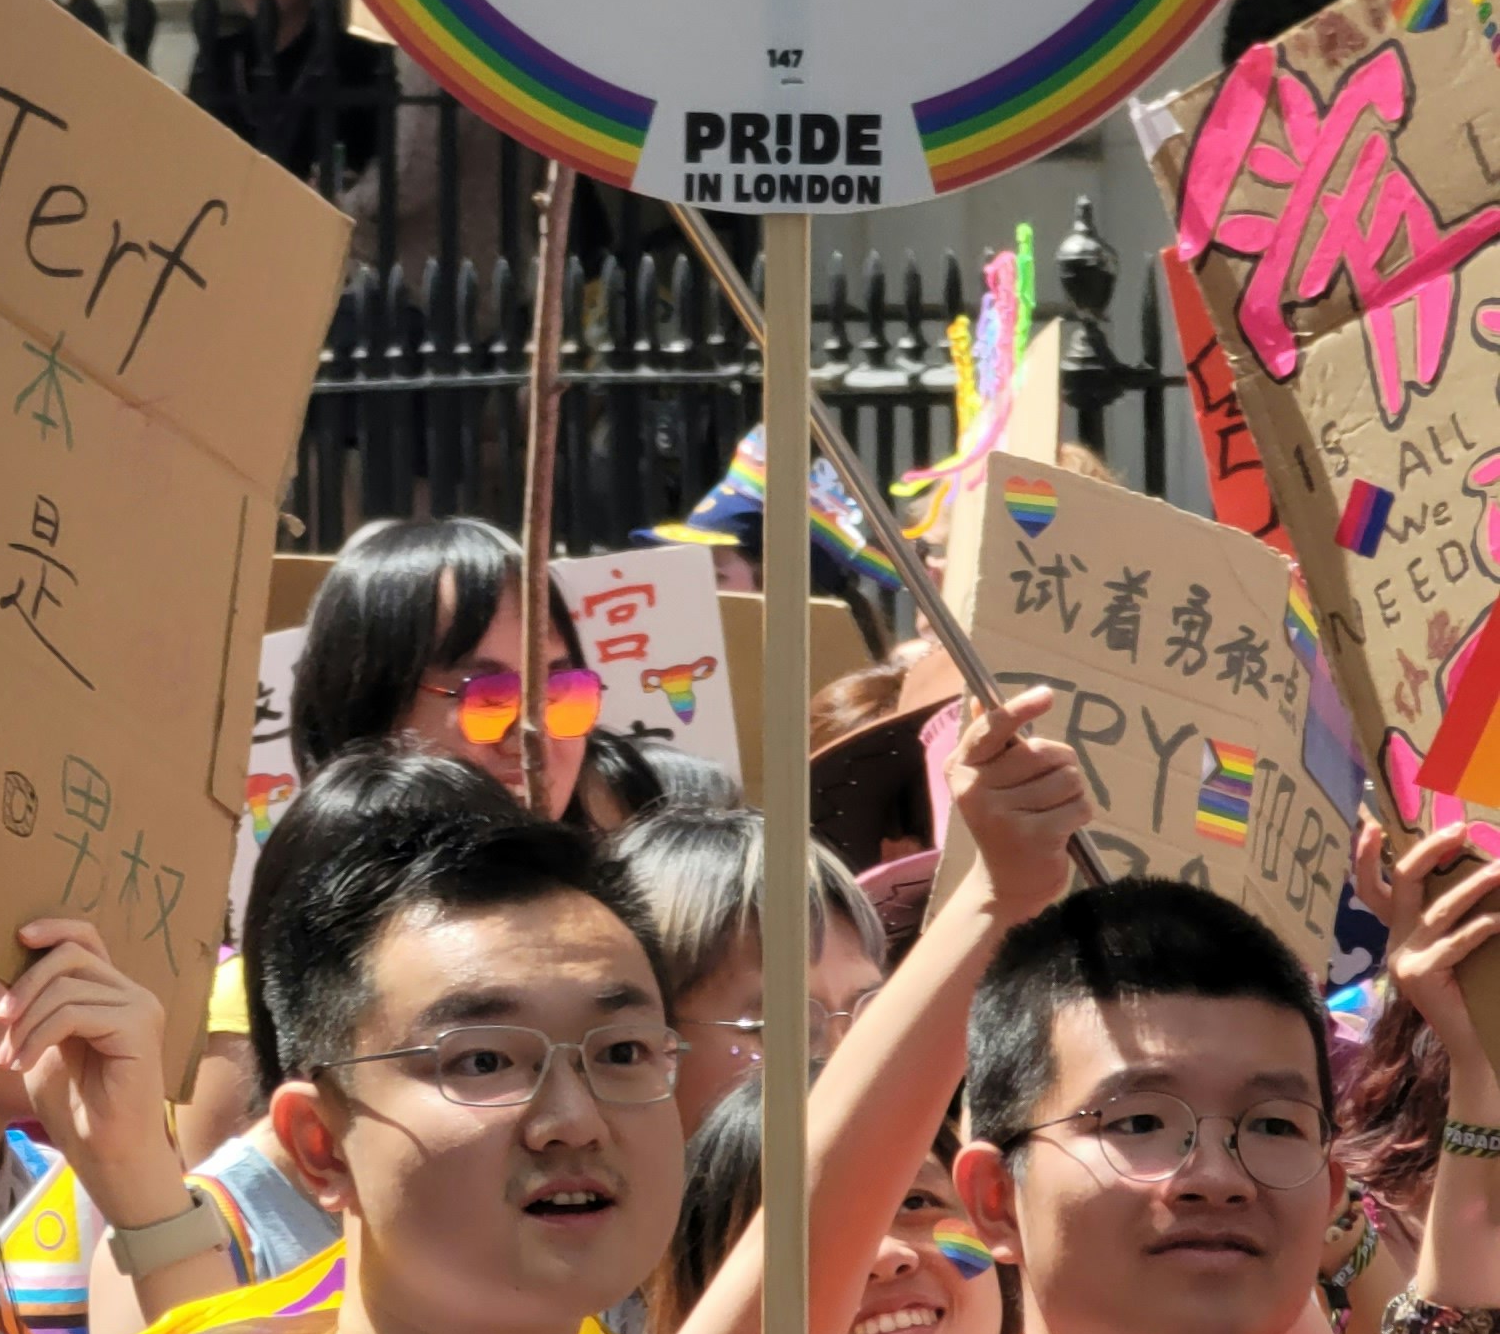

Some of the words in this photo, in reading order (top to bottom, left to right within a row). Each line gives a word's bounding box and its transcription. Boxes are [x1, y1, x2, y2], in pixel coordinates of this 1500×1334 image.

[766, 48, 805, 69] 147
[684, 173, 722, 203] IN
[733, 173, 882, 205] LONDON
[1328, 538, 1471, 654] NEED
